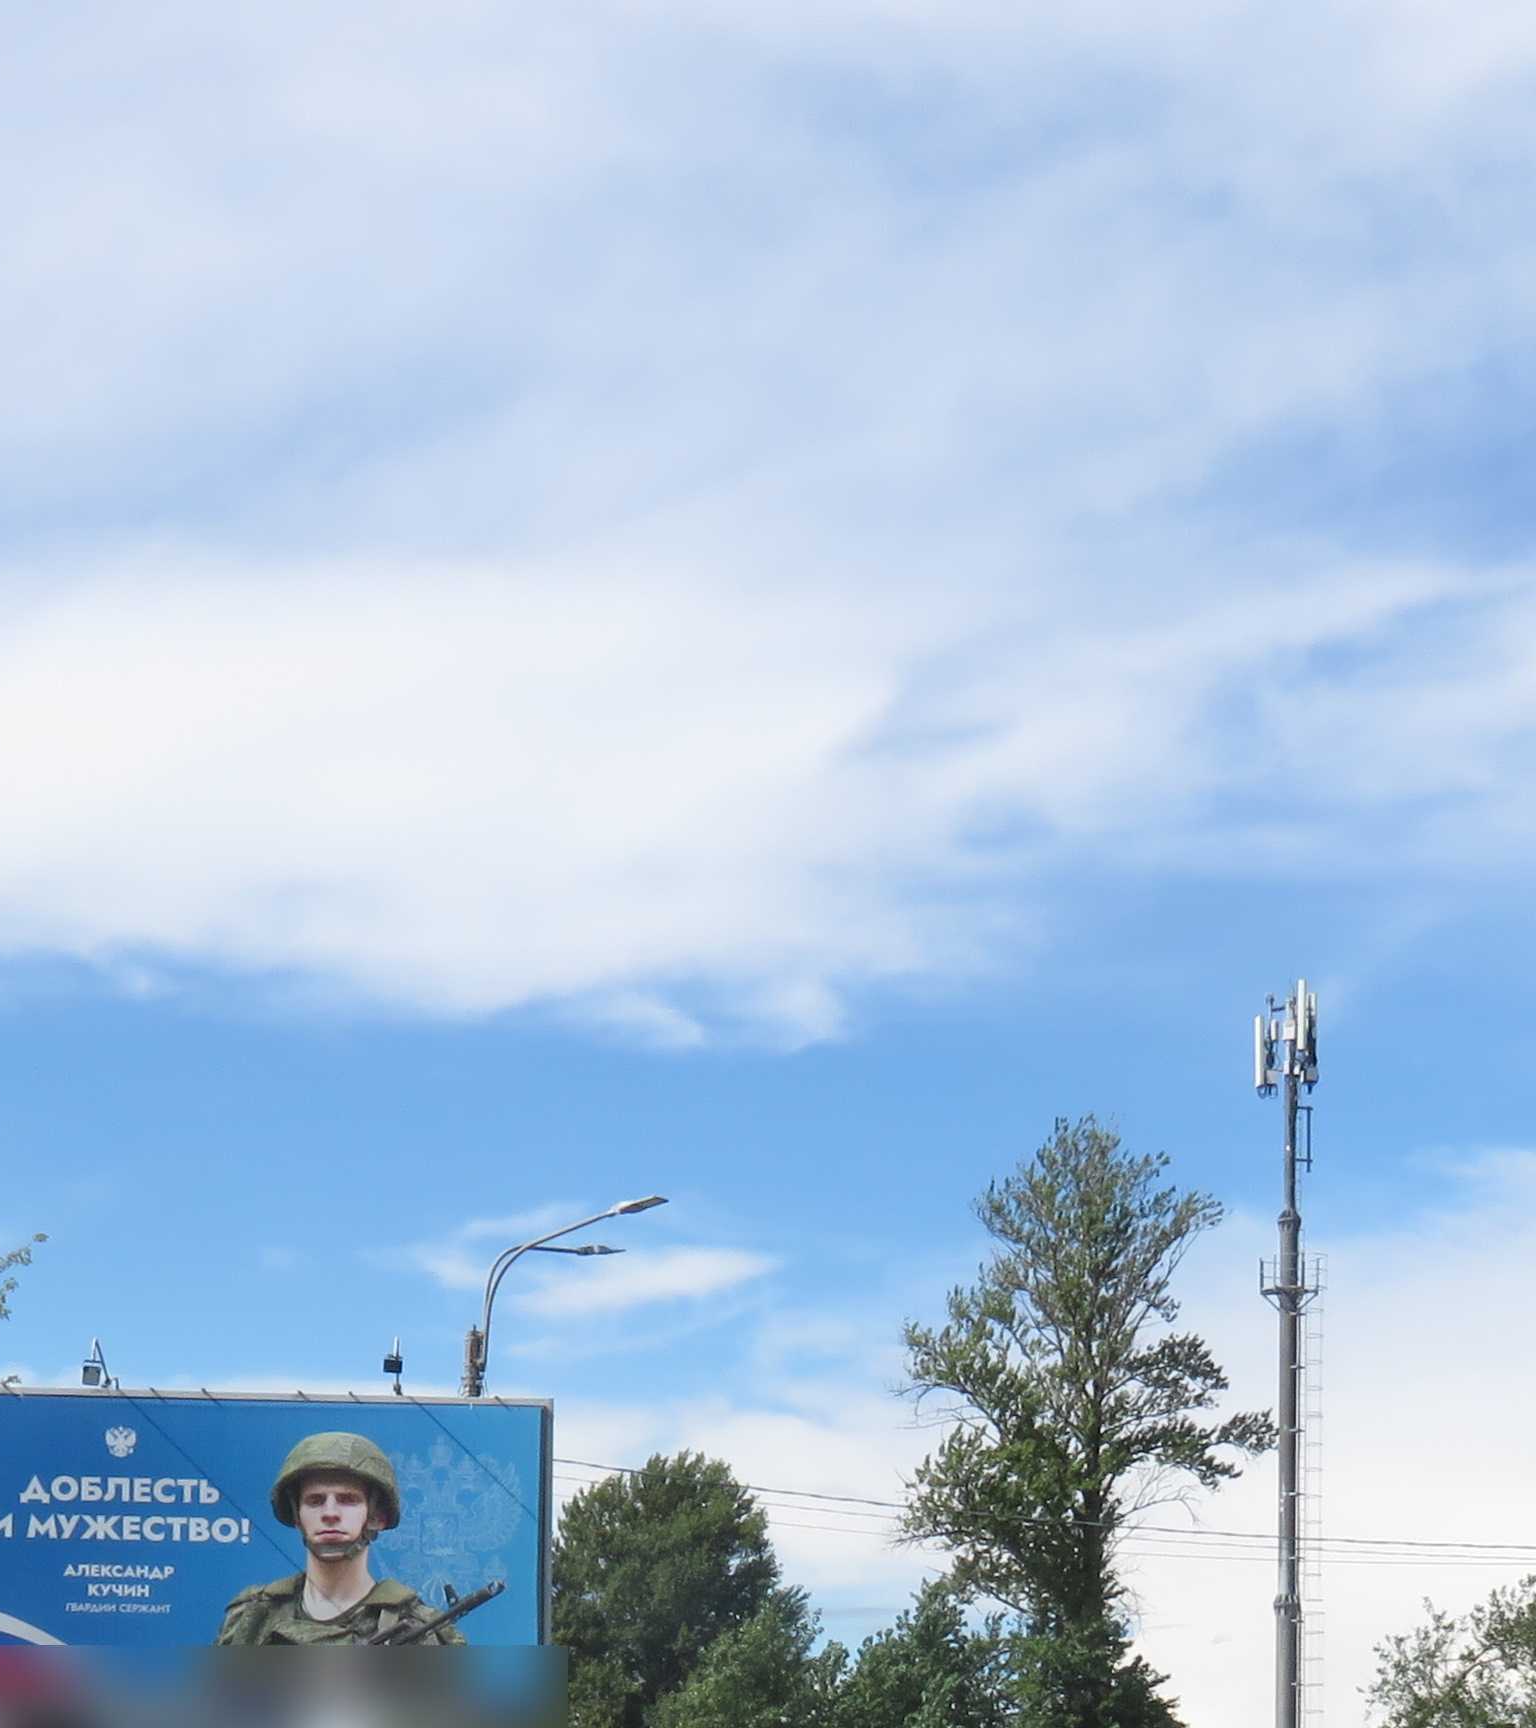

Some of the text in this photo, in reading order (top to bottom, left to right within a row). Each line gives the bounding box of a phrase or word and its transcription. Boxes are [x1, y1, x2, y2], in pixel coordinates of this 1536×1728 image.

[19, 1475, 220, 1504] ДОБЛЕСТЬ
[26, 1513, 251, 1544] МУЖЕСТВО!
[63, 1564, 175, 1579] АЛЕКСАНДР
[88, 1584, 150, 1597] КУЧИН
